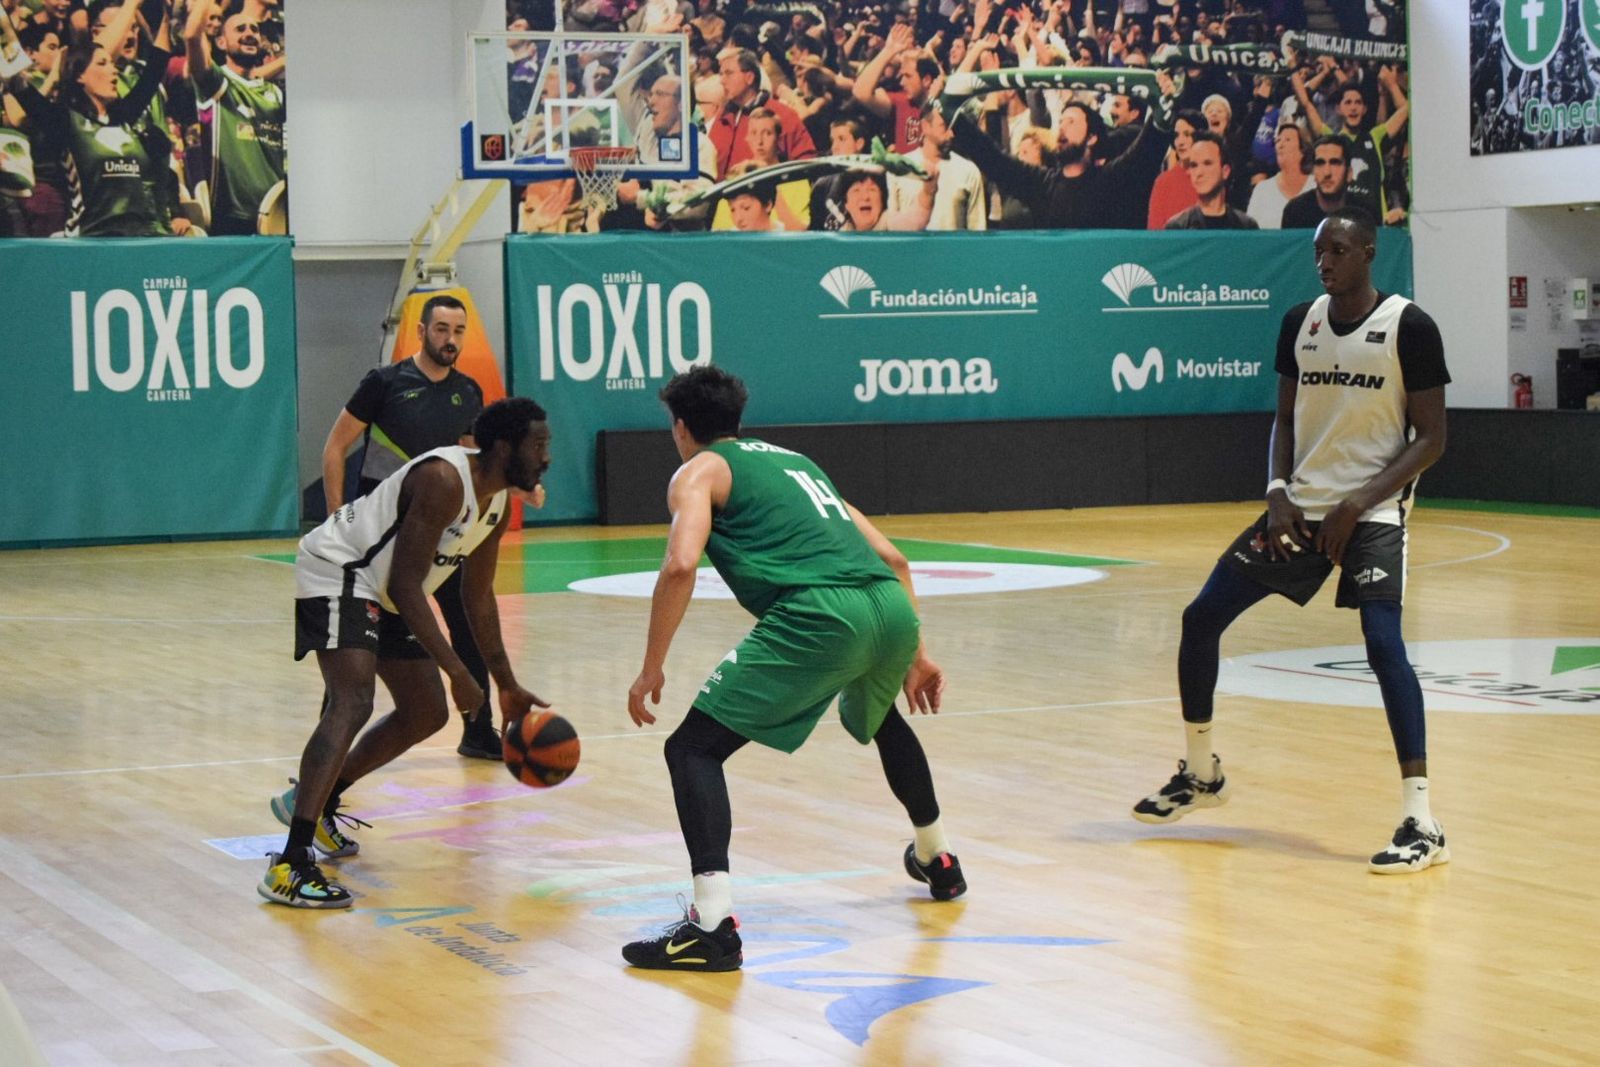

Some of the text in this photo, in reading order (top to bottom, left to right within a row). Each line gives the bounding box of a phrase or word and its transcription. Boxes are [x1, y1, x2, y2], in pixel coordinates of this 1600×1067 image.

[104, 159, 140, 175] Unicaja
[143, 276, 188, 290] CAMPAÑA
[601, 270, 643, 284] CAMPAÑA
[1153, 284, 1270, 307] Unicaja Banco
[1176, 357, 1262, 378] Movistar
[605, 378, 646, 391] CANTERA
[146, 388, 191, 402] CANTERA
[783, 468, 851, 521] 14
